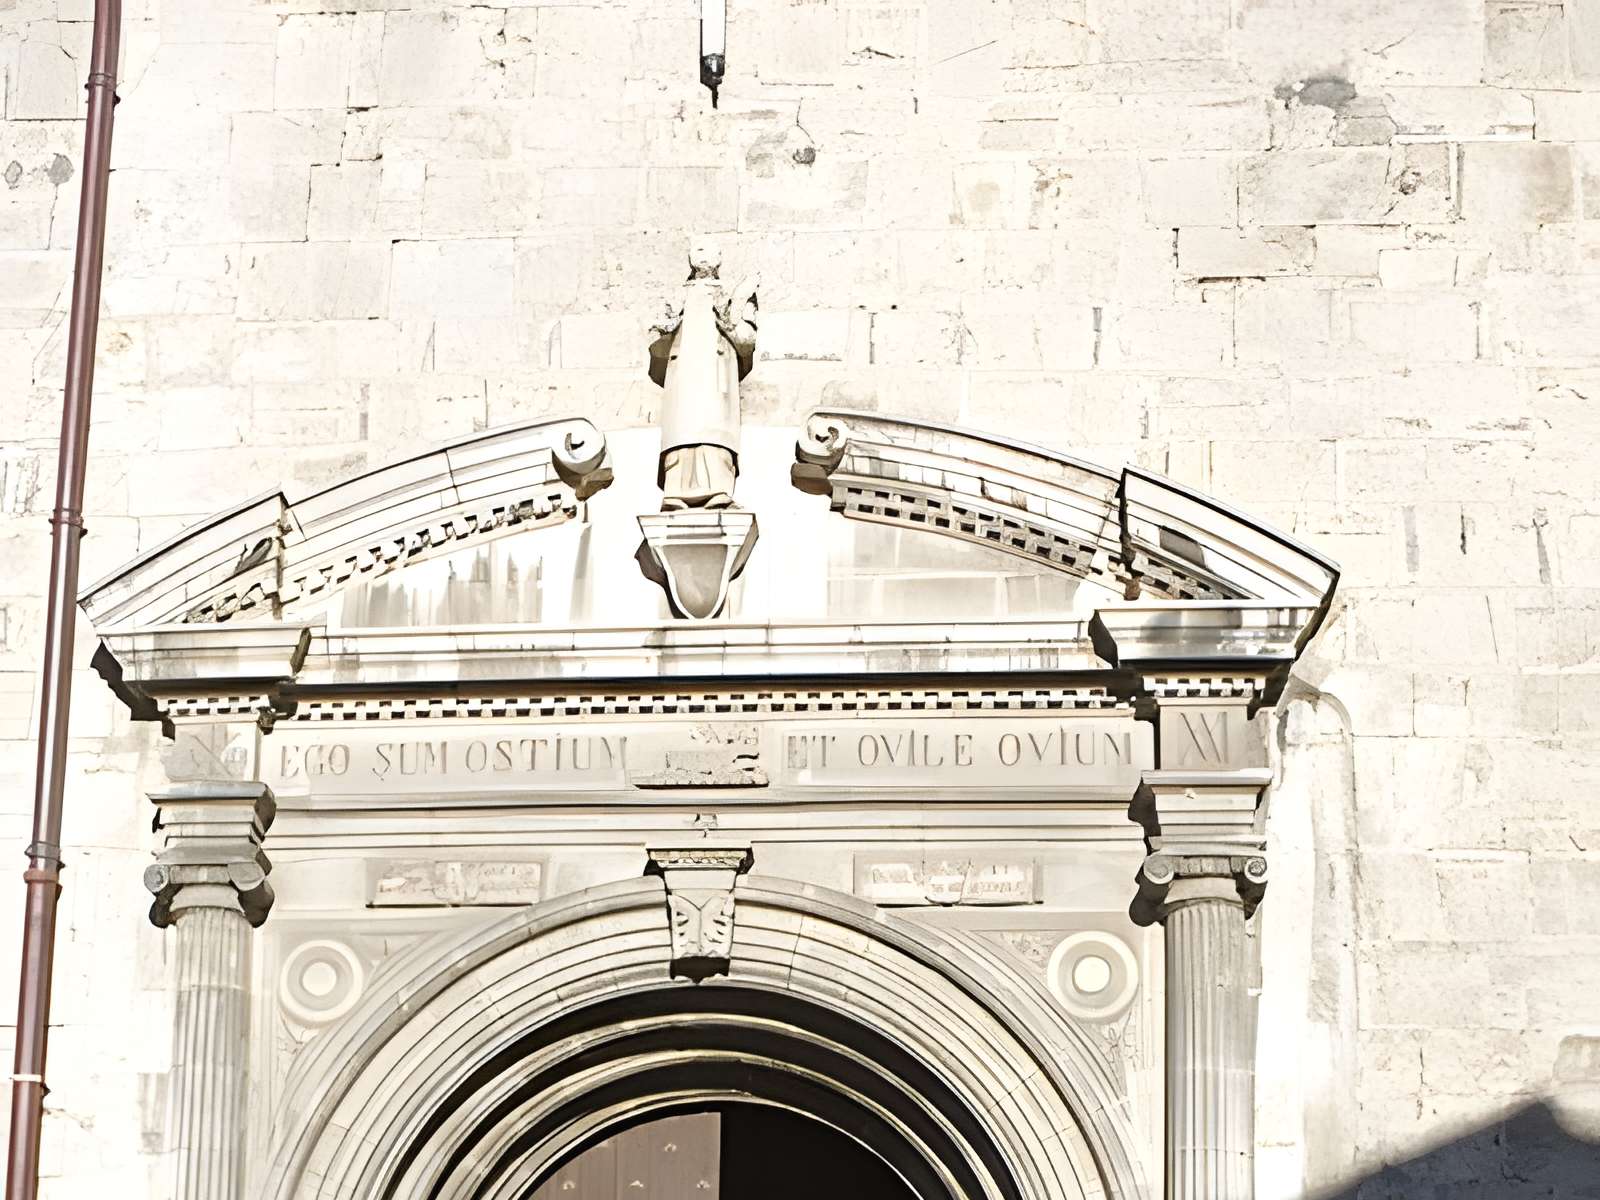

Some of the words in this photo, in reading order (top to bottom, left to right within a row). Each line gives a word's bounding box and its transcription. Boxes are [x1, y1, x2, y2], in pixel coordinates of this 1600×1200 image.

[280, 743, 350, 778] EGO
[371, 741, 448, 780] SUM
[858, 730, 973, 767] OVILE
